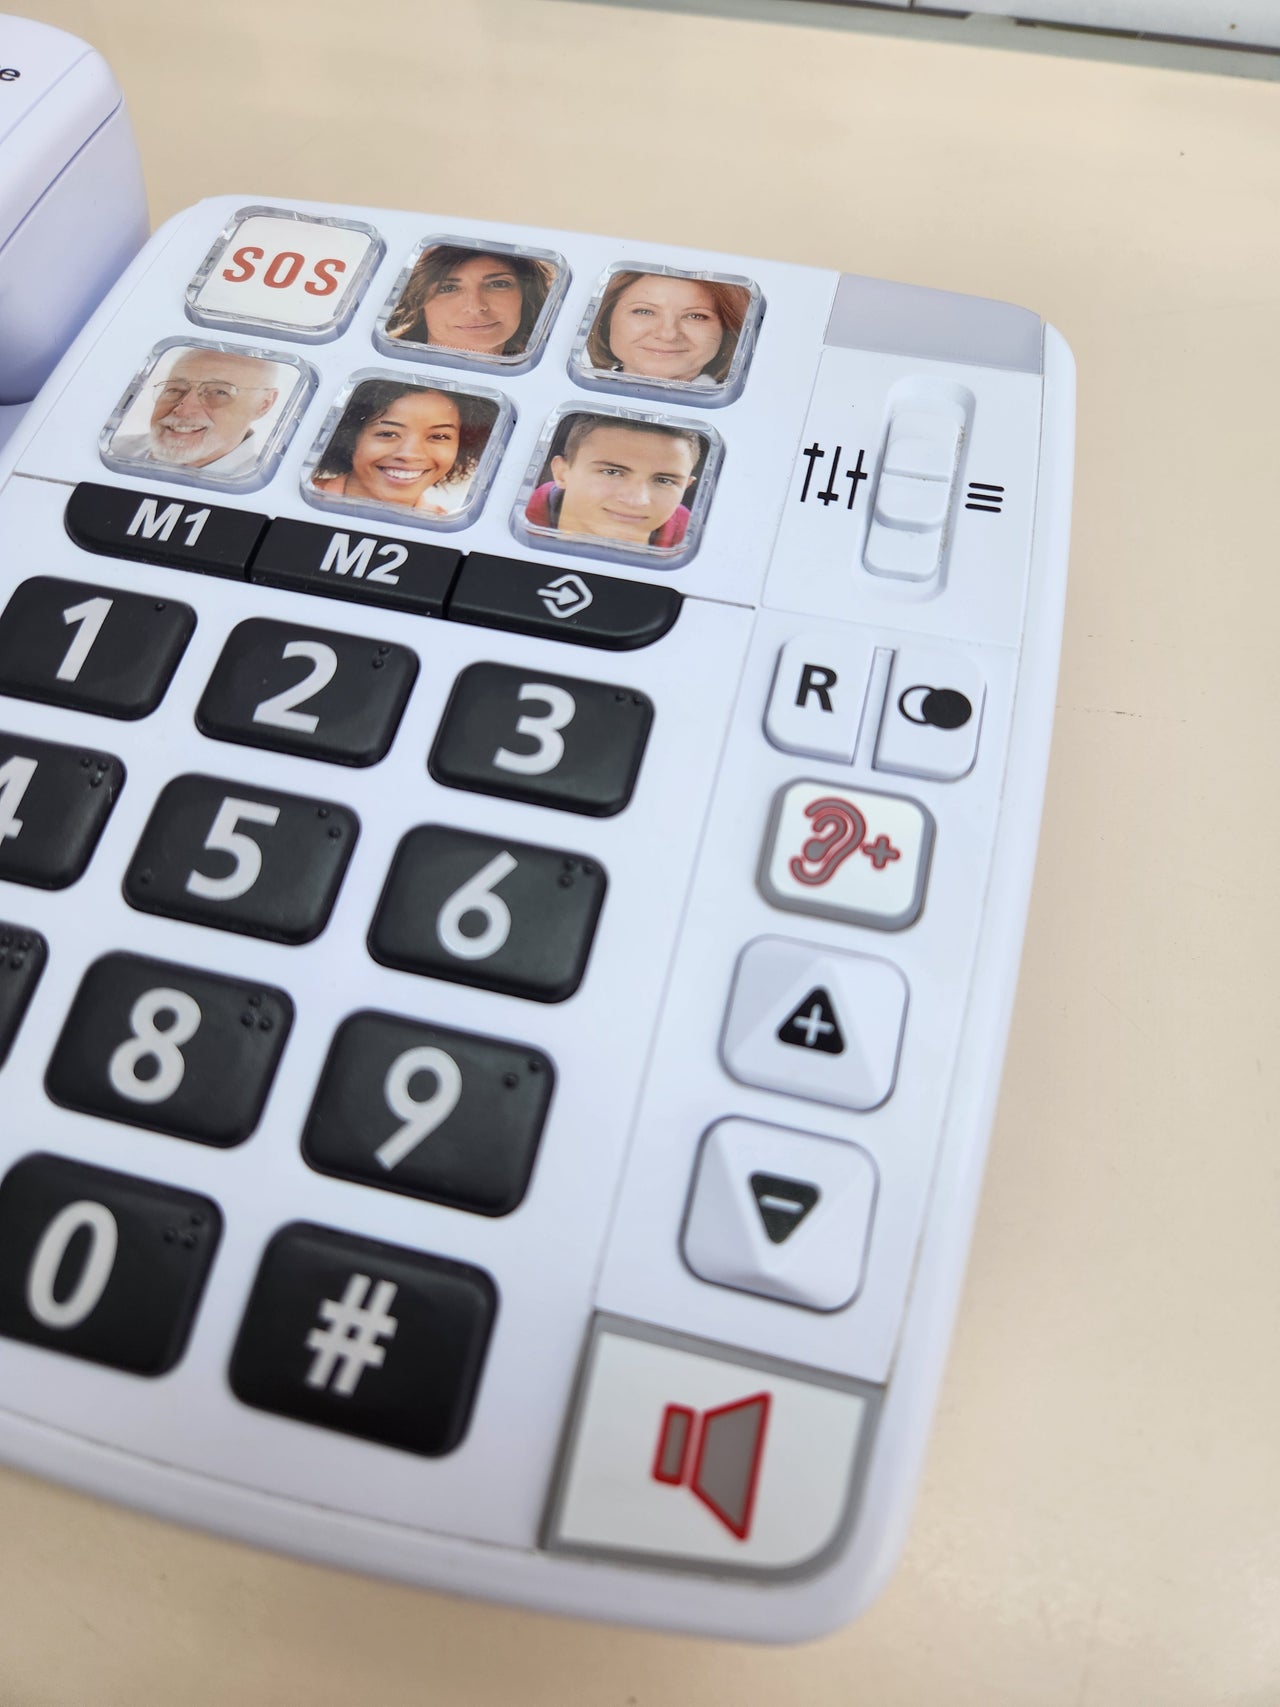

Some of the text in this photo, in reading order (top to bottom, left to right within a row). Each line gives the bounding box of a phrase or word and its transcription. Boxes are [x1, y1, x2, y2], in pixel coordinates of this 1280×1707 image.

[222, 246, 346, 297] SOS
[126, 498, 211, 547] M1
[319, 532, 409, 586] M2
[56, 596, 115, 682] 1
[252, 640, 338, 733] 2
[493, 682, 576, 775] 3
[795, 663, 838, 713] R
[186, 795, 281, 900] 5
[437, 849, 518, 960] 6
[109, 987, 202, 1103] 8
[375, 1045, 463, 1170] 9
[27, 1200, 118, 1329] 0
[305, 1273, 398, 1396] #
